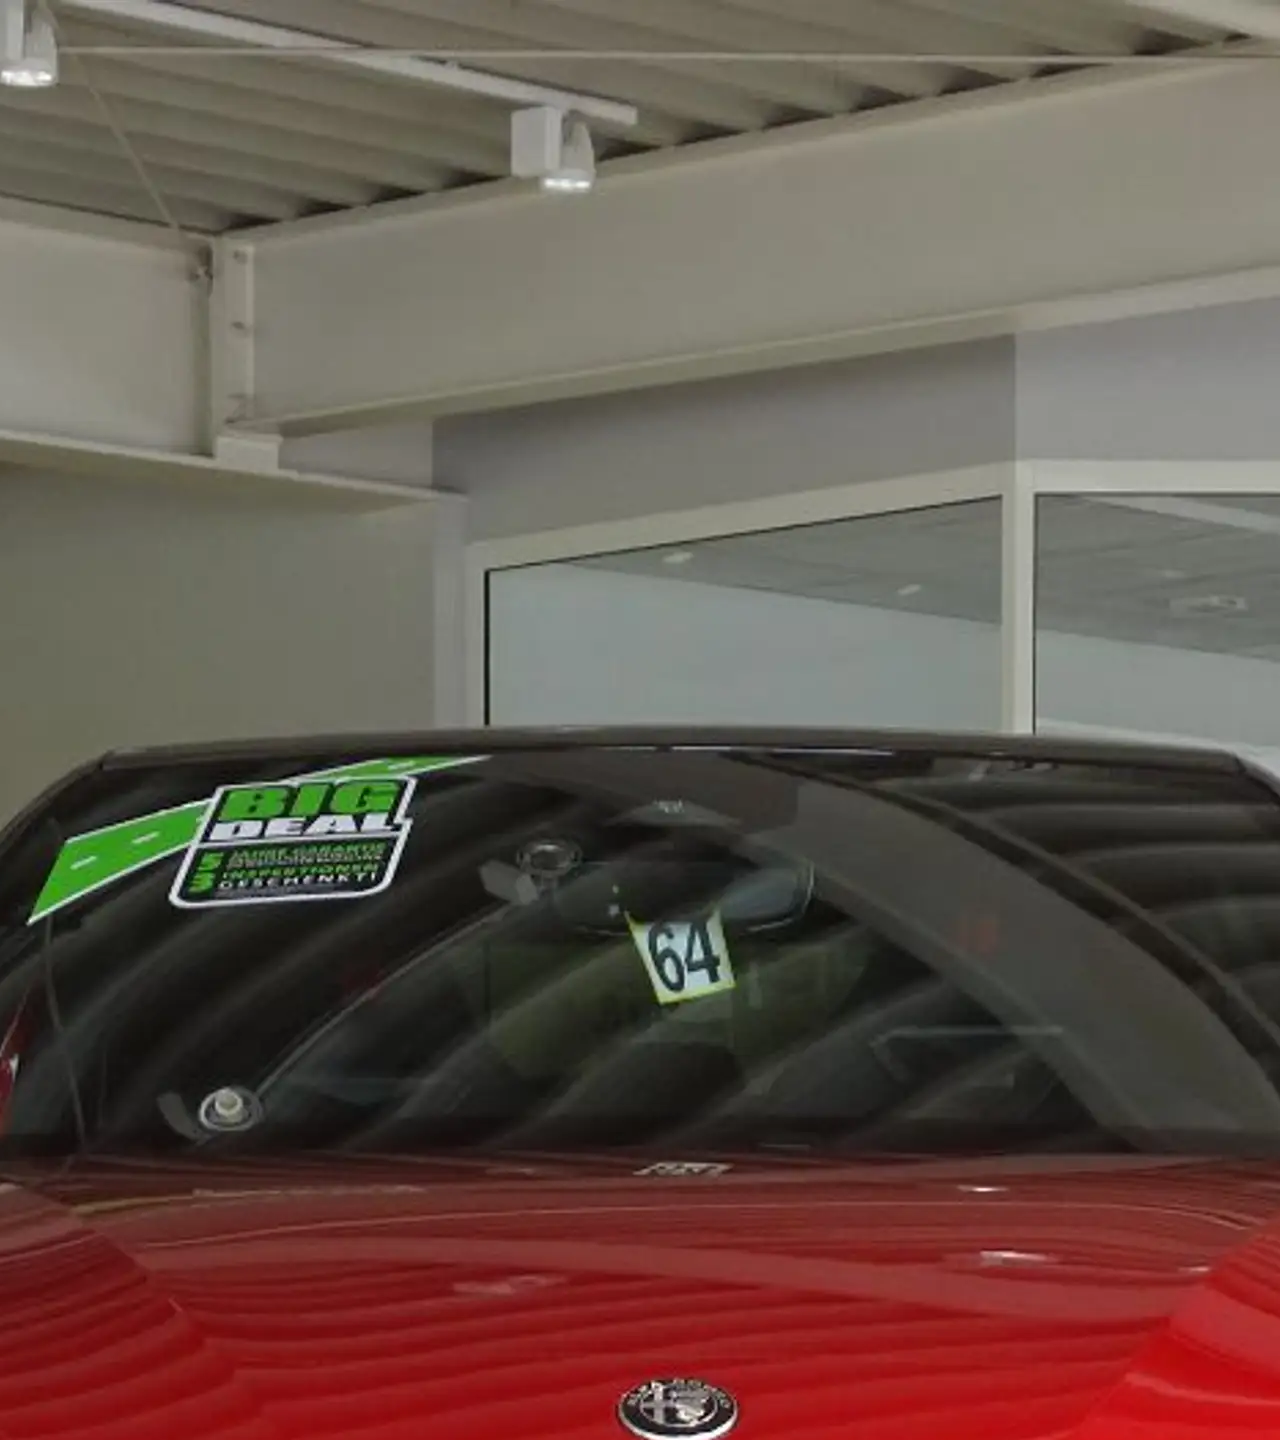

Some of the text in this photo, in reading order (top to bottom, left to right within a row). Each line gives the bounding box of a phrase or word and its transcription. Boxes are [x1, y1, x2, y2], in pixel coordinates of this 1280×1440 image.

[219, 782, 400, 820] BIG
[209, 812, 400, 840] DEAL
[648, 920, 721, 992] 64
